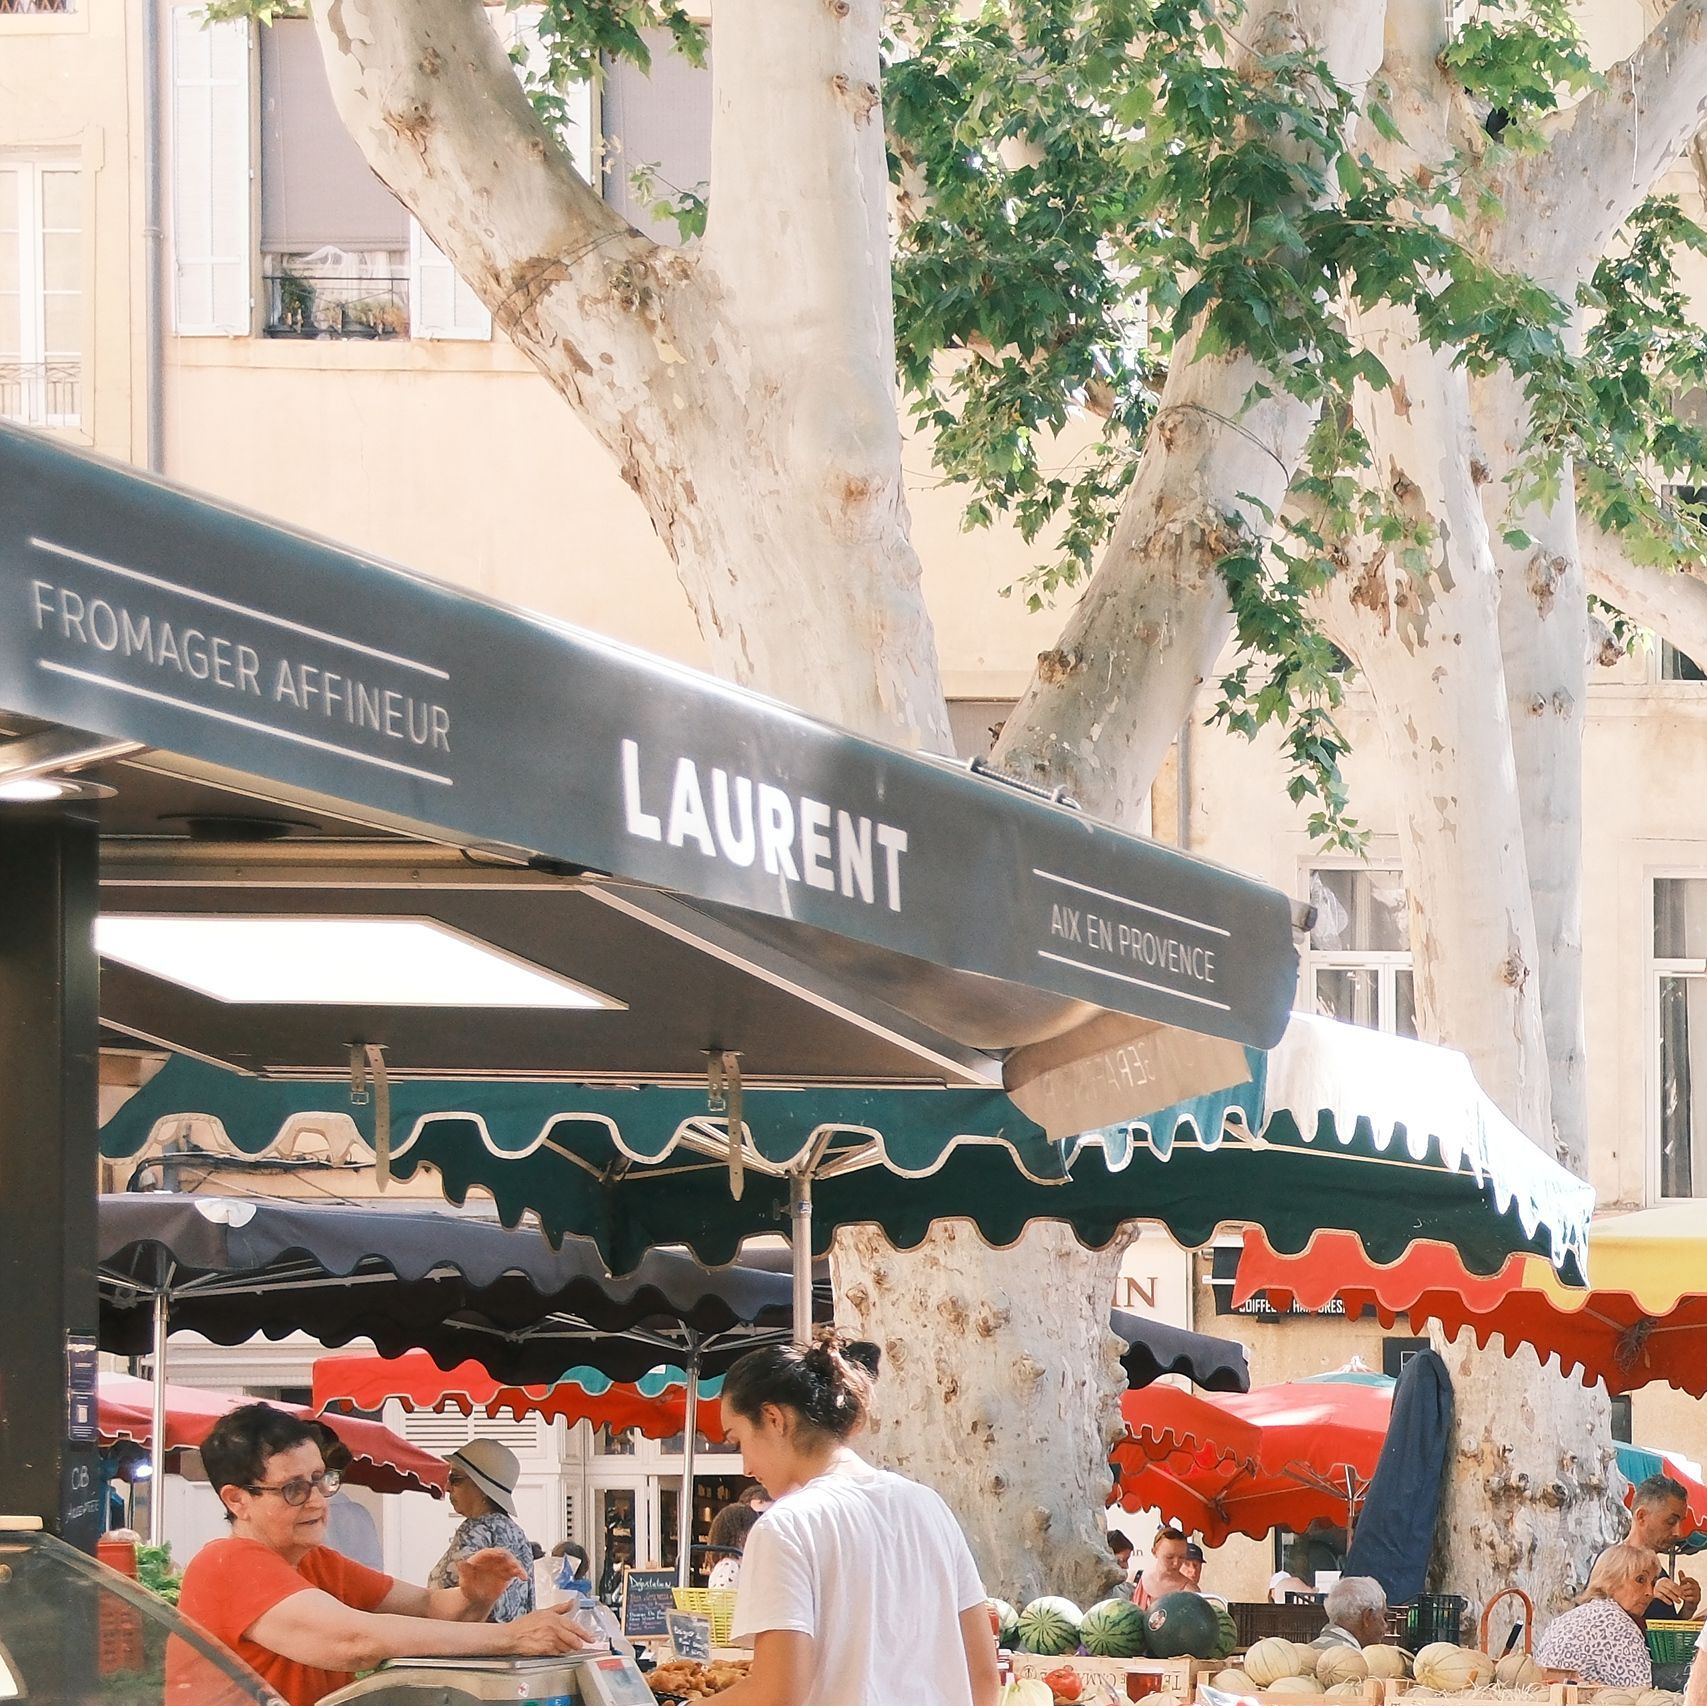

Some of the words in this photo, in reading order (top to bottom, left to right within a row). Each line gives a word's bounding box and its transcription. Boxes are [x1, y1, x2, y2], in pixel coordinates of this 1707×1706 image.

[32, 579, 262, 697] FROMAGER
[274, 659, 452, 753] AFFINEUR
[620, 738, 909, 913] LAURENT
[1051, 903, 1083, 944] AIX
[1086, 913, 1114, 953] EN
[1118, 924, 1216, 984] PROVENCE
